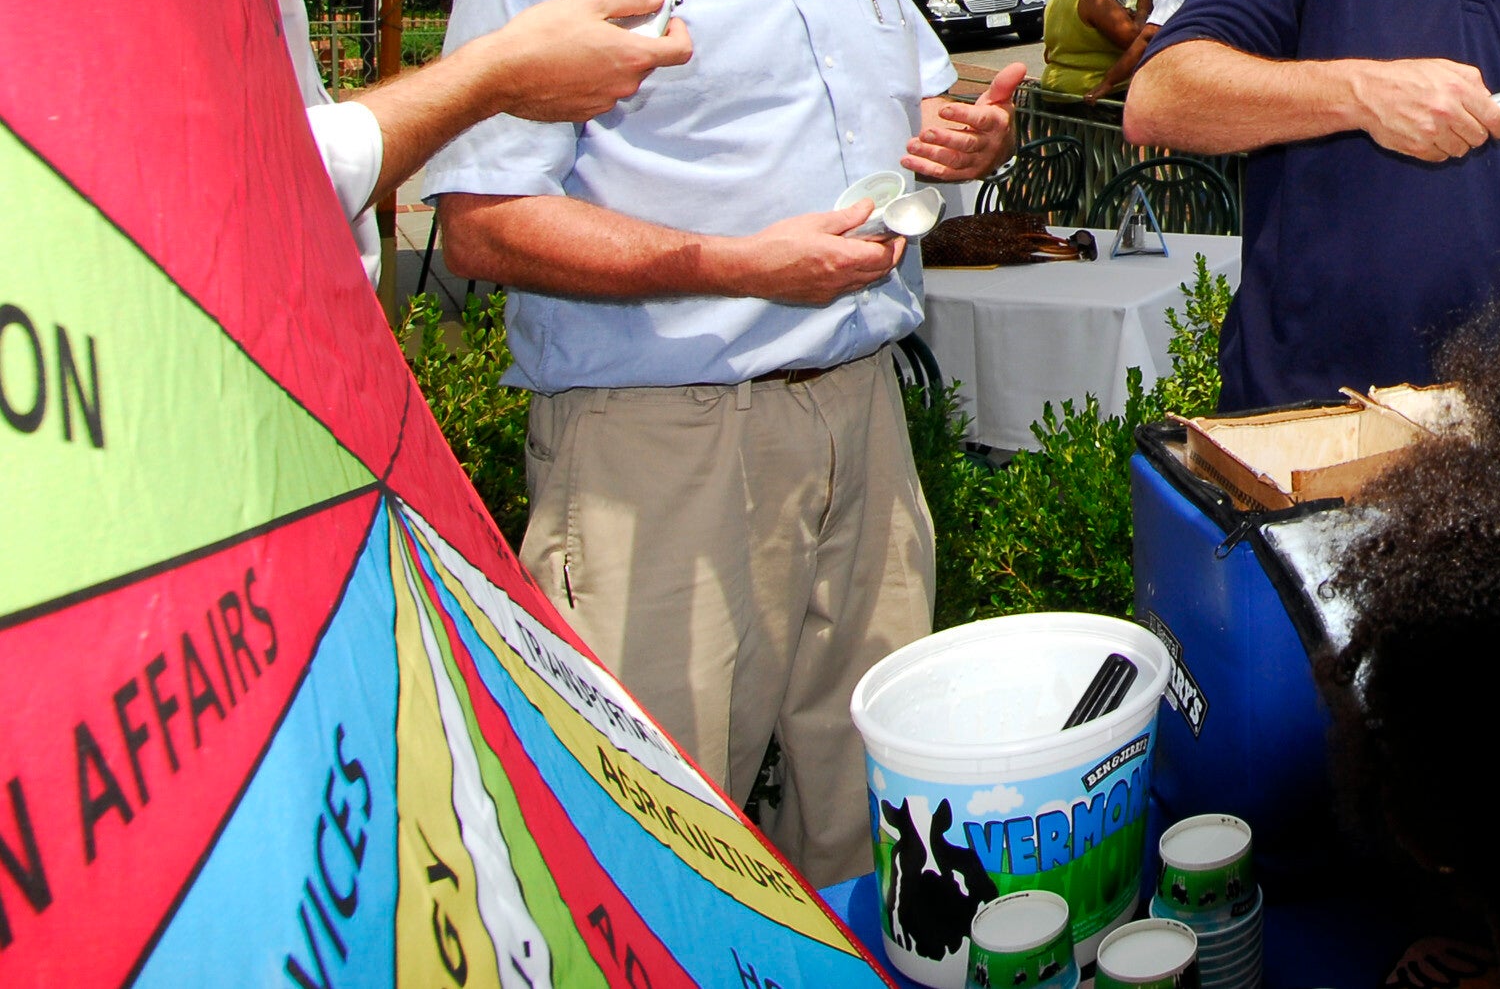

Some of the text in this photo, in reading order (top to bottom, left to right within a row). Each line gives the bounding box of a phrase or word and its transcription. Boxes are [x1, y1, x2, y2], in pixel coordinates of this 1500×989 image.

[74, 566, 279, 866] AFFAIRS
[417, 817, 469, 989] GY
[597, 745, 806, 904] AGRICULTURE
